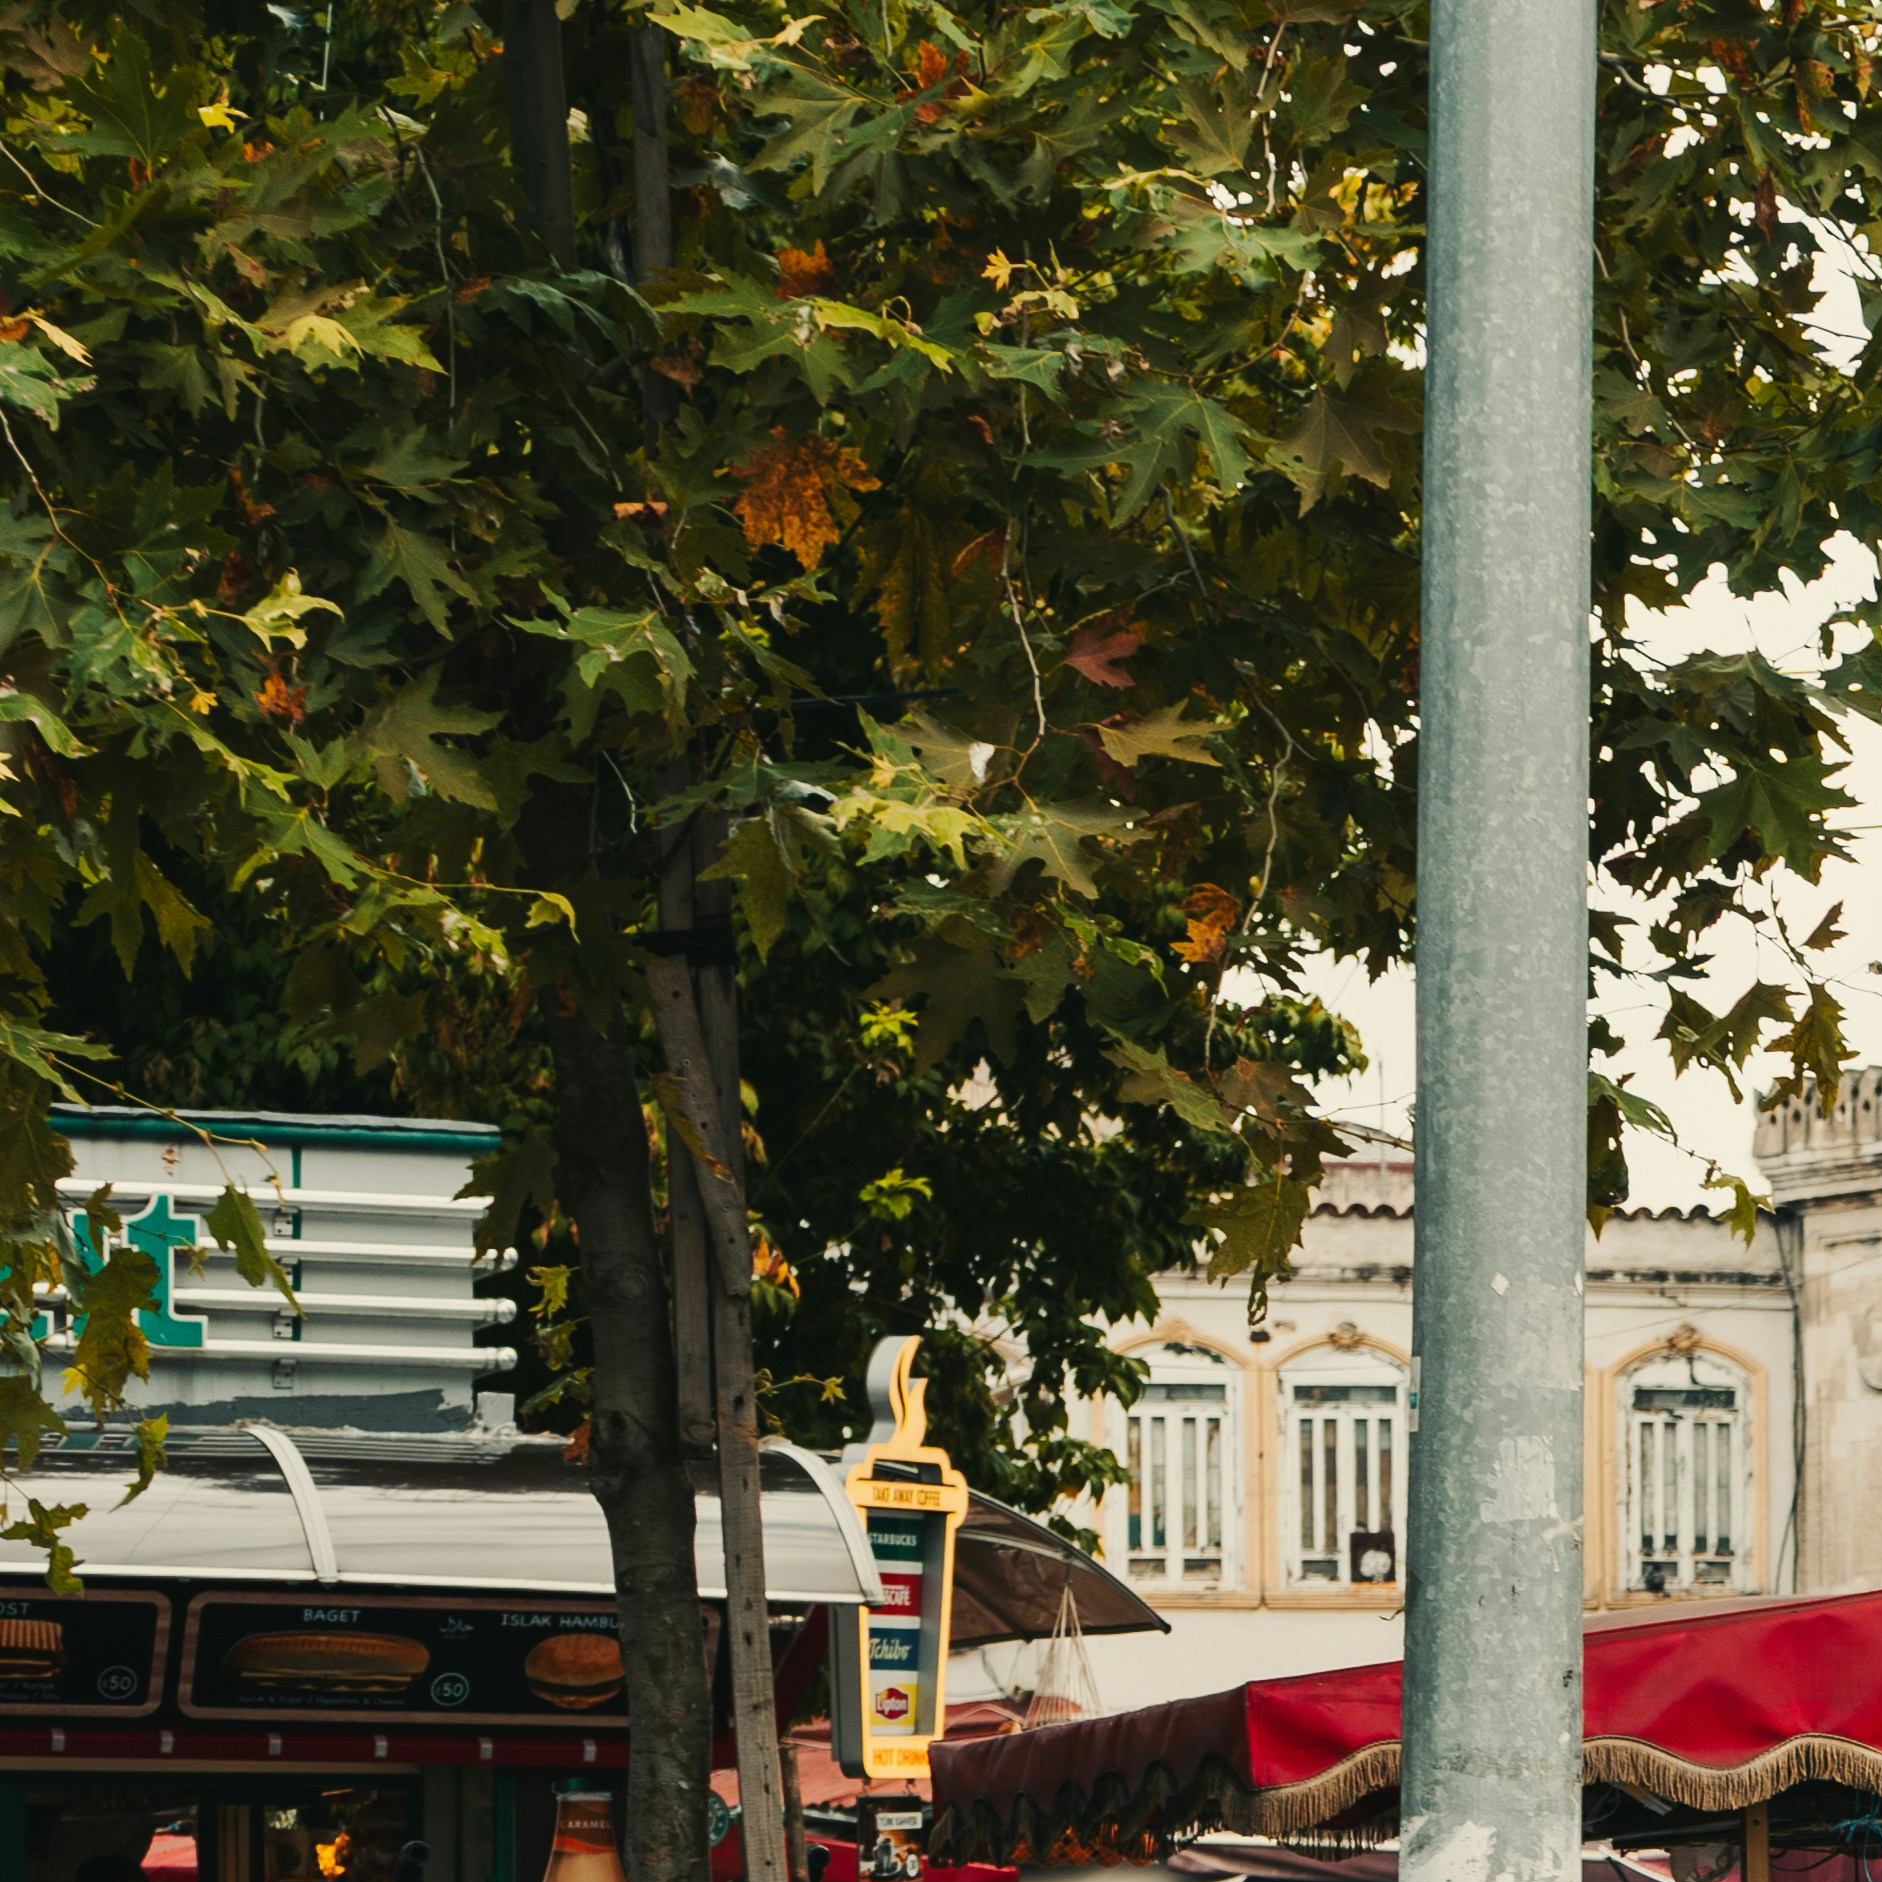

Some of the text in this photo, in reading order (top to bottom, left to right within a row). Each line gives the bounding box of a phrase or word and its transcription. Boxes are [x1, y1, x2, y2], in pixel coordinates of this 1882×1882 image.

[872, 1486, 890, 1502] TAKE
[892, 1487, 913, 1504] AWAY
[867, 1531, 917, 1547] STARBUCKS
[303, 1609, 361, 1622] BAGET
[559, 1616, 622, 1629] HAMBU
[870, 1637, 912, 1661] Tchibo
[876, 1694, 908, 1713] Lipton
[872, 1748, 894, 1767] HOT
[560, 1820, 612, 1829] CARAMEL
